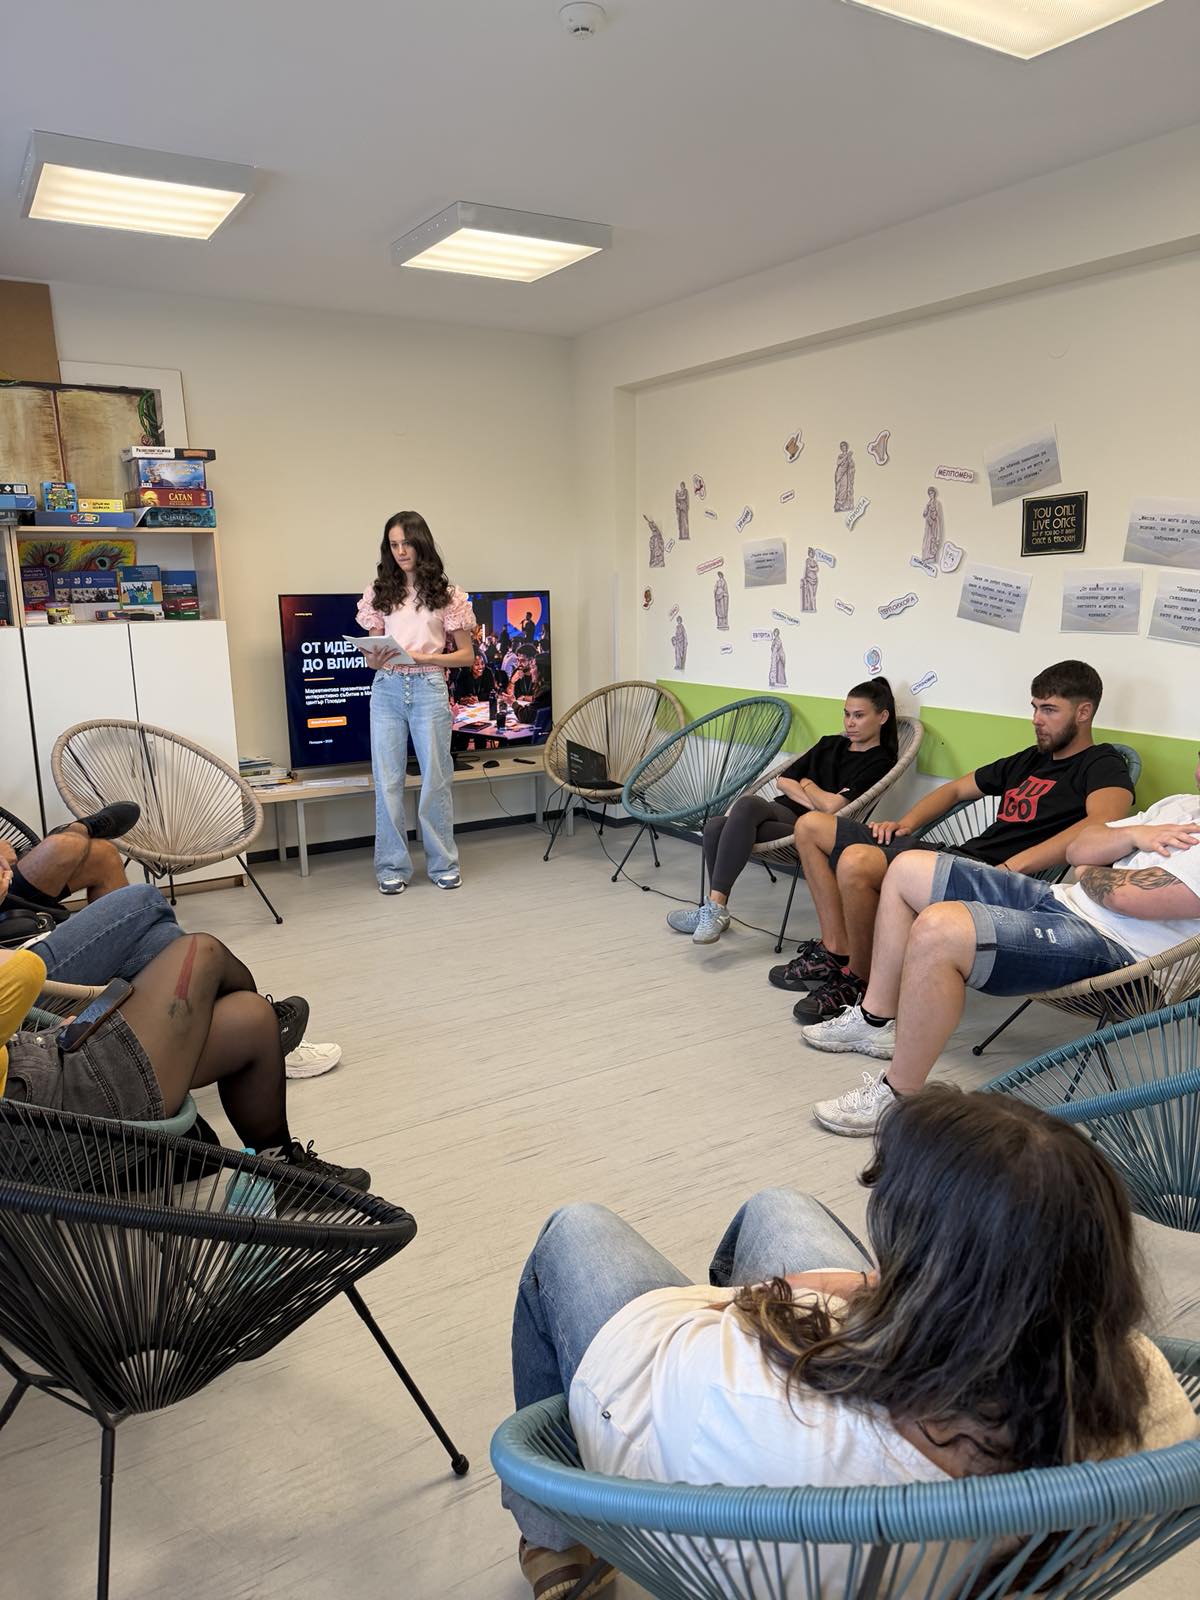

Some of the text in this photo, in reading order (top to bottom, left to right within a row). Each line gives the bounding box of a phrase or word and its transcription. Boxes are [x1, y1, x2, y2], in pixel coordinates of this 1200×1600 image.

[168, 493, 193, 501] CATAN
[1033, 504, 1076, 518] YOU ONLY
[1032, 517, 1076, 530] LIVE ONCE
[1054, 535, 1075, 543] ENOUGH
[301, 642, 321, 654] ОТ
[302, 659, 323, 673] ДО
[1005, 797, 1032, 820] GO
